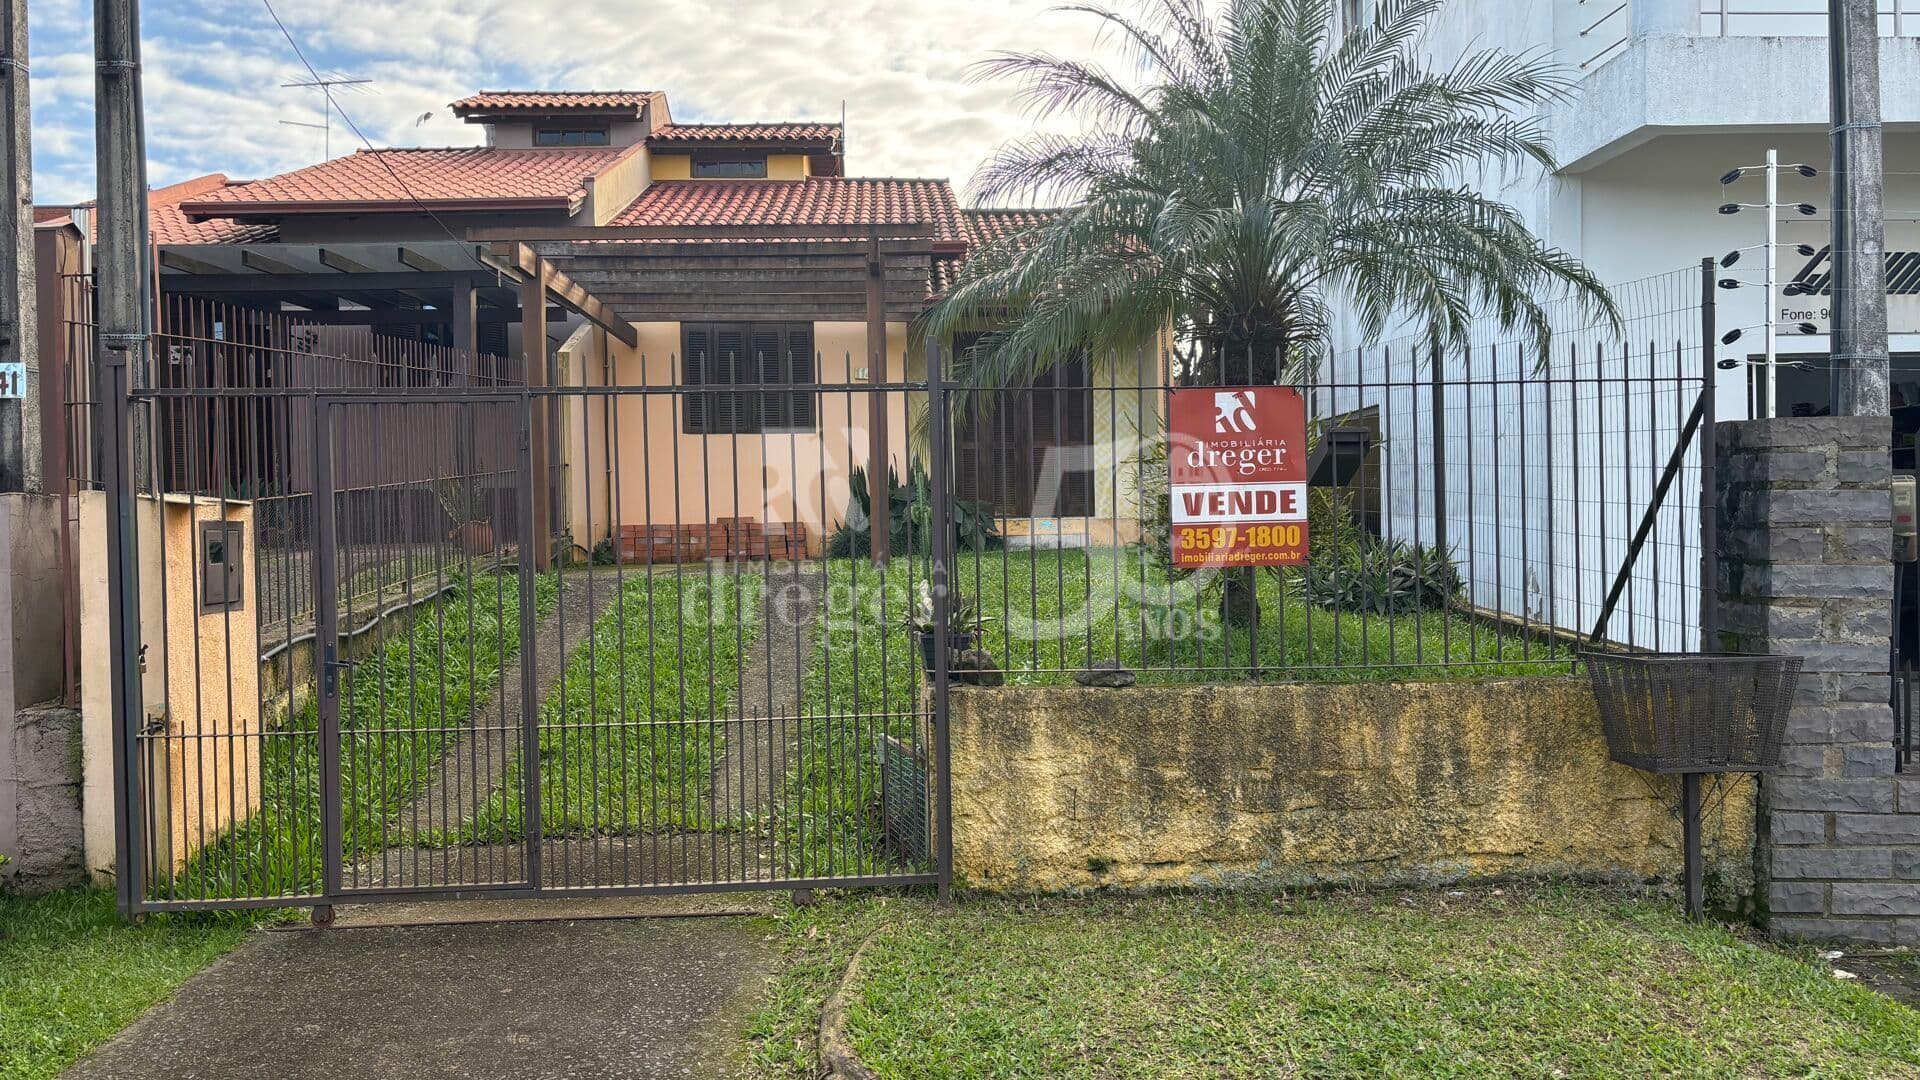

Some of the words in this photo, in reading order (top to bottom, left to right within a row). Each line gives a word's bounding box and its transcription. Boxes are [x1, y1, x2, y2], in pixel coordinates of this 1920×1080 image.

[1781, 308, 1816, 320] Fone:
[1820, 308, 1831, 320] 9
[1205, 436, 1287, 448] IMOBILIÁRIA
[1187, 440, 1287, 476] dreger
[1182, 490, 1297, 516] VENDE
[1180, 524, 1301, 550] 3597-1800
[1181, 552, 1300, 563] imobiliariadreger.com.br
